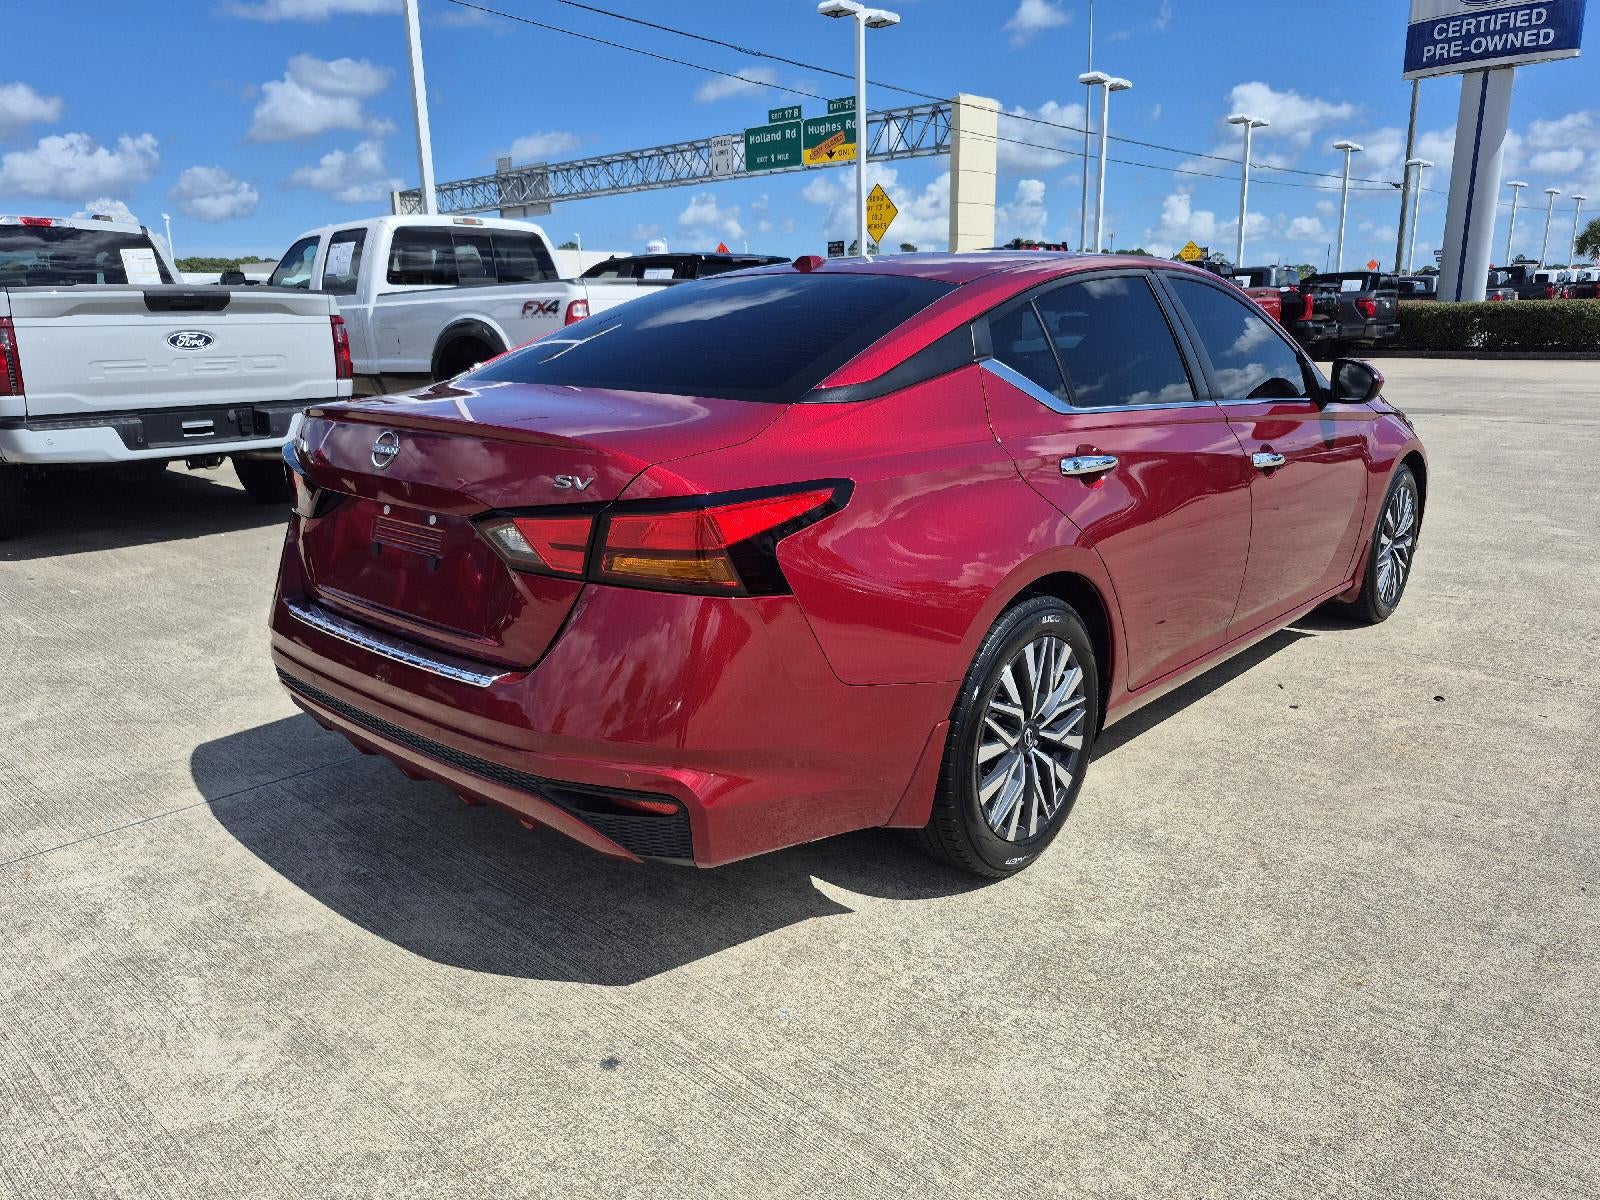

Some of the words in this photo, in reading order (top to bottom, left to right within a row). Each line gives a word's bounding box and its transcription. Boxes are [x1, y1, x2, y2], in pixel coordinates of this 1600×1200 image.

[1433, 7, 1547, 40] CERTIFIED
[1423, 28, 1555, 63] PRE-OWNED
[830, 102, 842, 111] EXIT
[771, 112, 782, 120] EXIT
[749, 131, 781, 144] Holland
[785, 128, 796, 140] Rd
[808, 122, 841, 136] Hughes
[713, 139, 730, 148] SPEED
[757, 155, 768, 164] EXIT
[776, 153, 789, 161] MILE
[837, 148, 856, 157] ONLY
[522, 299, 560, 315] FX4
[176, 333, 206, 347] Ford
[88, 354, 289, 380] F-150
[372, 444, 399, 454] SSAN
[553, 474, 595, 491] SV
